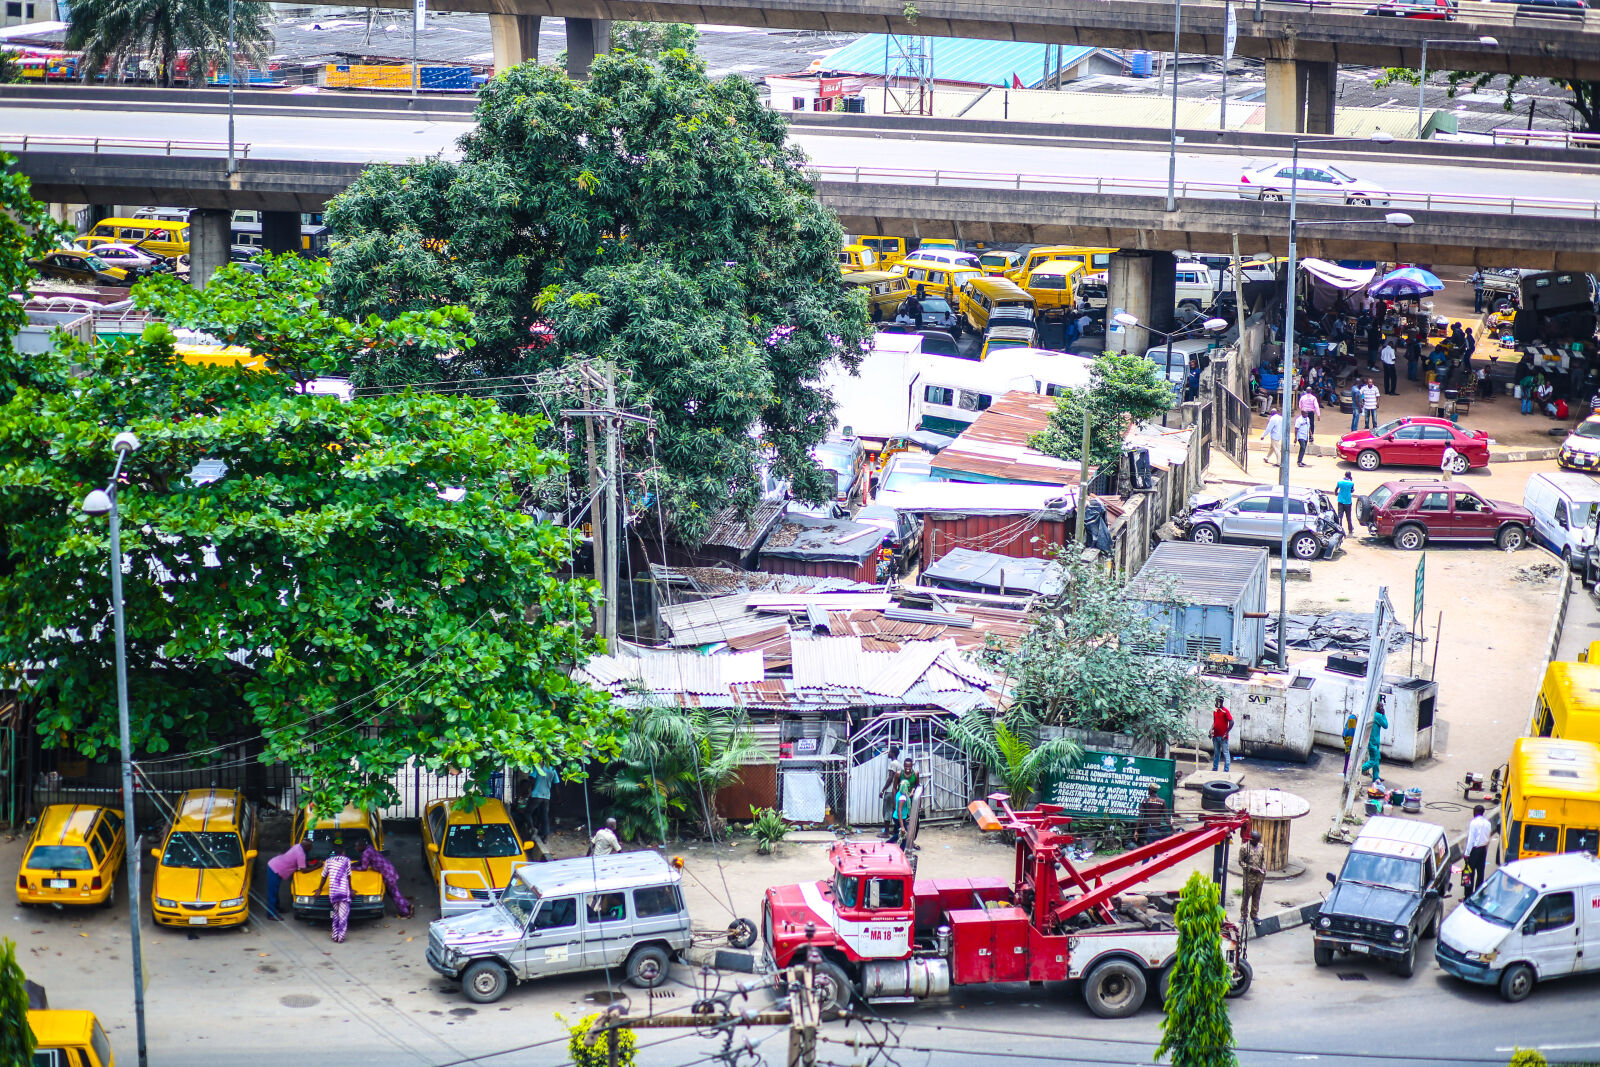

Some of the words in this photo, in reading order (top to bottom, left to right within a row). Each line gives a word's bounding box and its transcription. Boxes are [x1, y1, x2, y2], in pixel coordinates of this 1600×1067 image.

[1083, 762, 1101, 770] LAGOS
[1122, 766, 1141, 775] STATE
[1057, 789, 1098, 799] REGISTRATION
[1106, 793, 1129, 802] MOTOR
[1058, 781, 1098, 791] REGISTRATION
[1106, 786, 1128, 795] MOTOR
[1128, 788, 1150, 797] VEHICL
[1056, 795, 1083, 804] GENUINE
[1110, 799, 1135, 809] VEHICLE
[1082, 805, 1099, 813] AUTO
[870, 931, 881, 940] MA
[883, 931, 892, 940] 18
